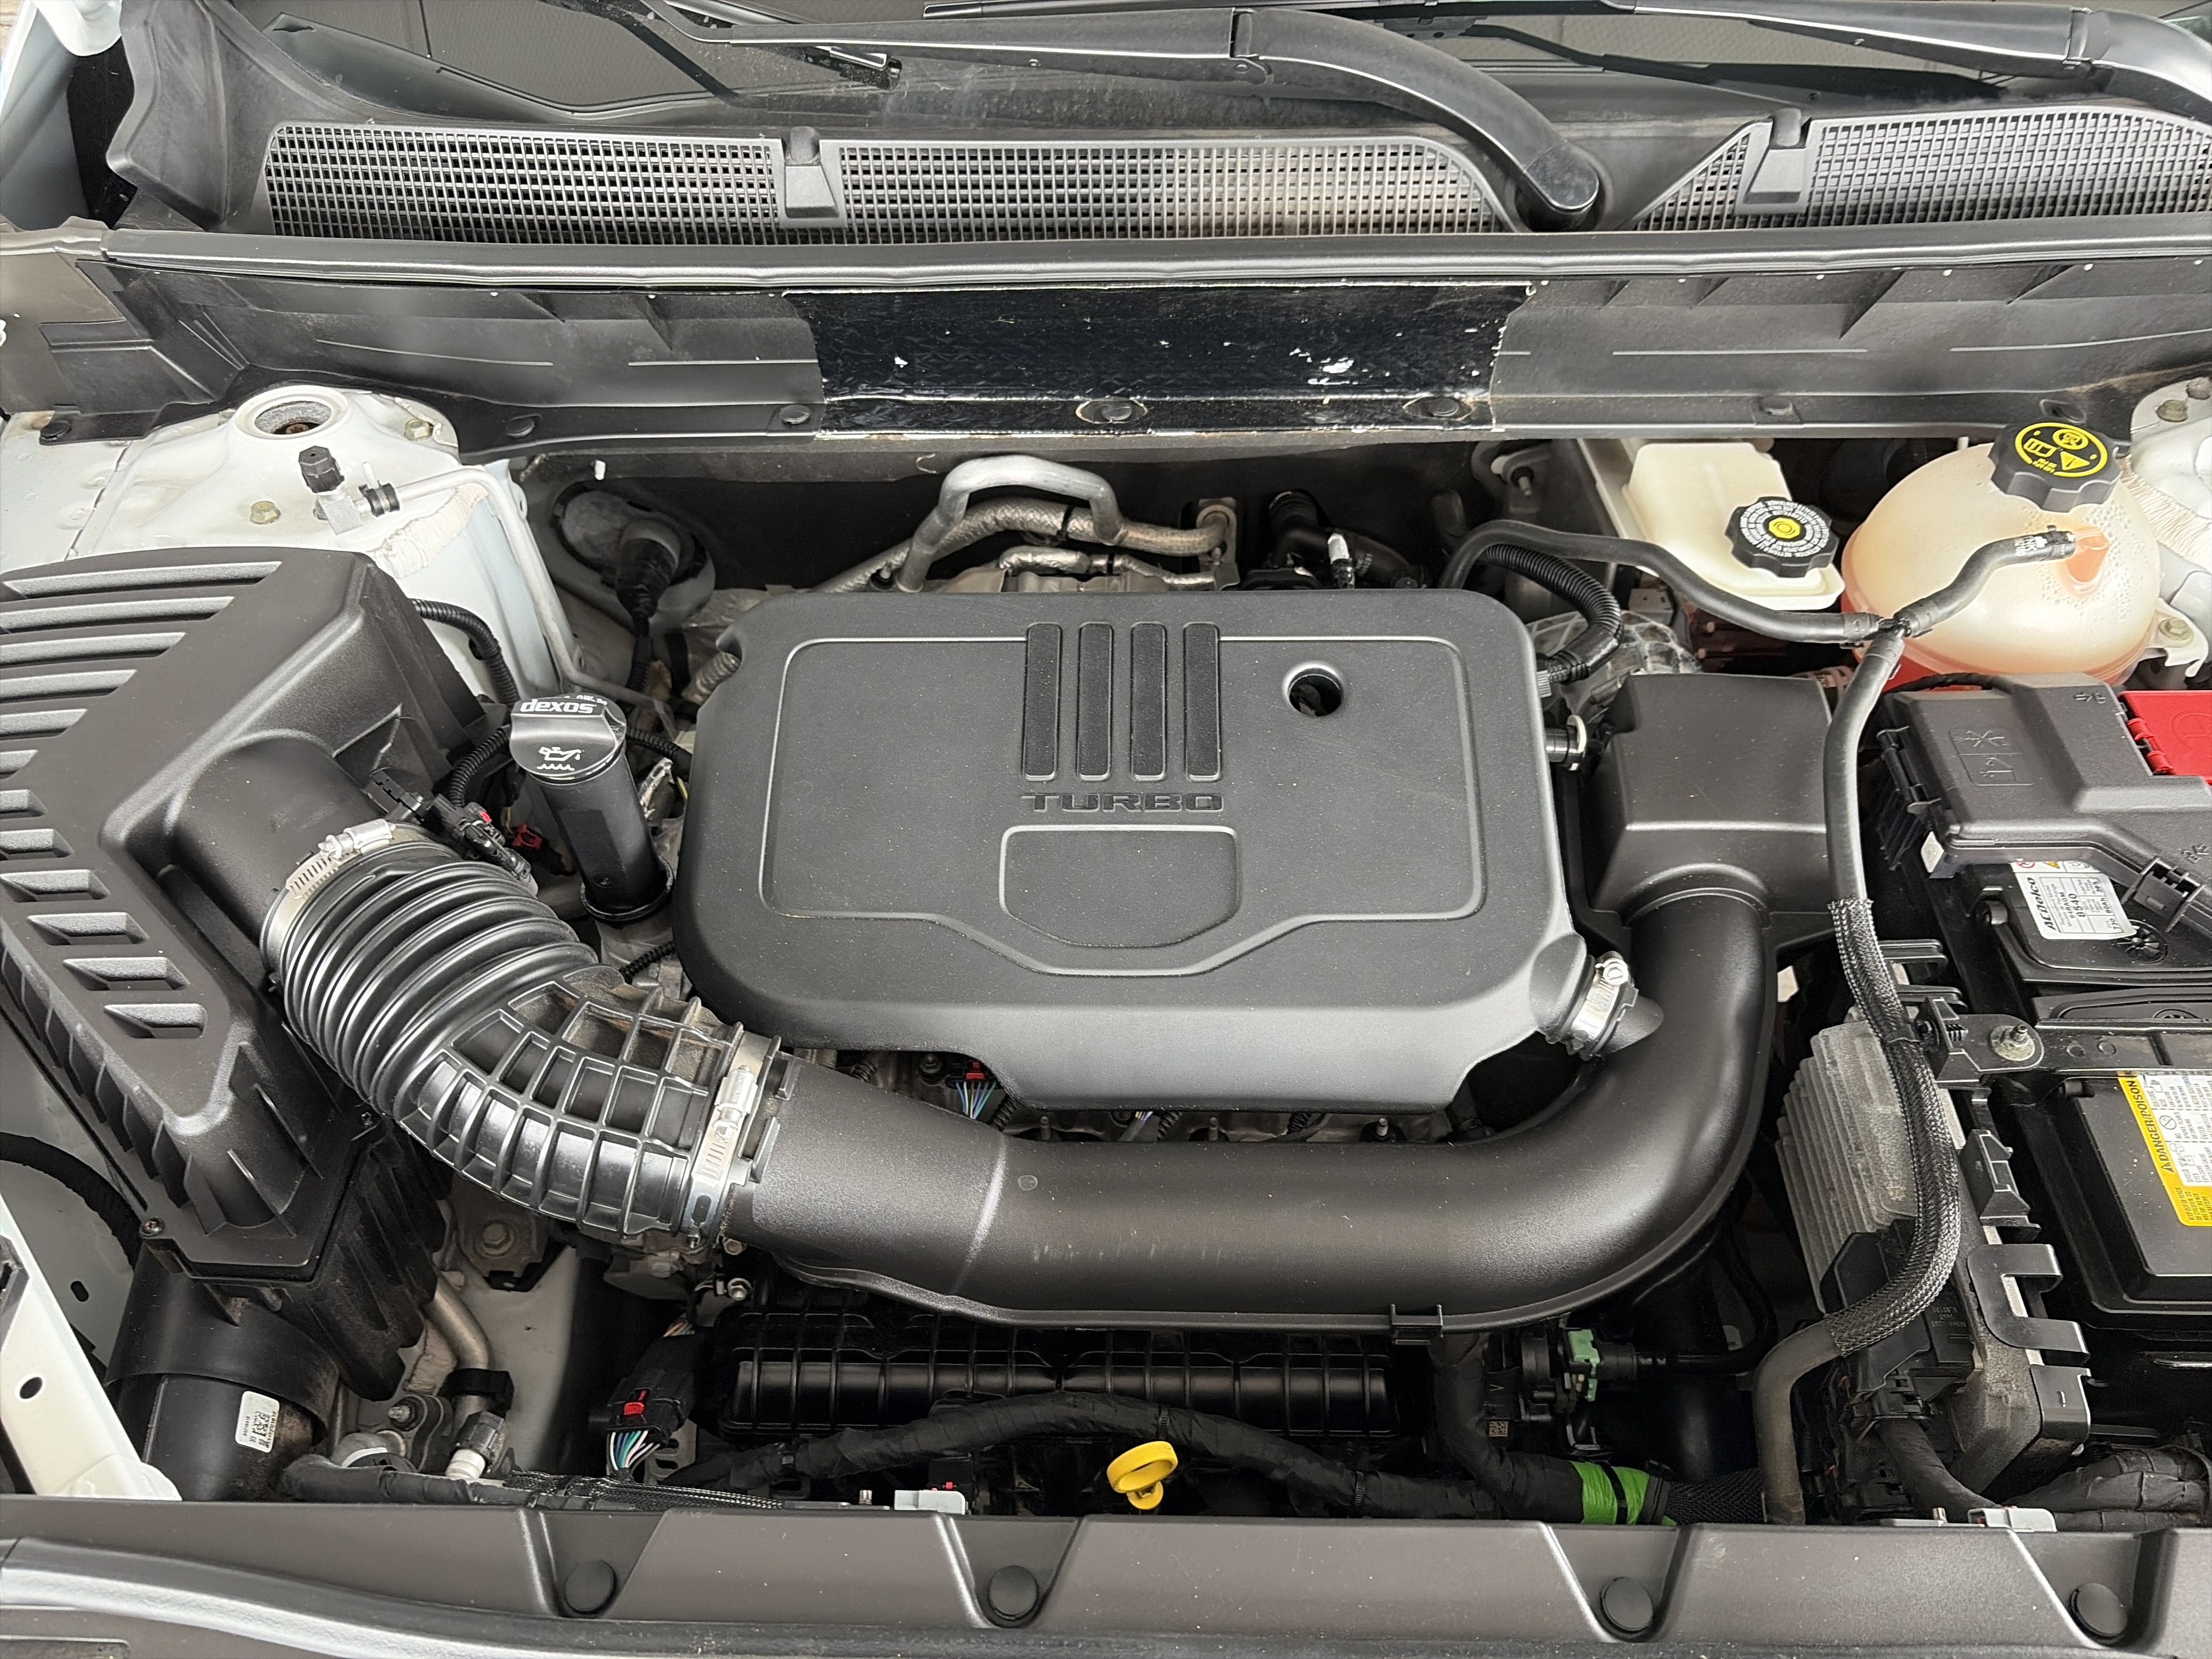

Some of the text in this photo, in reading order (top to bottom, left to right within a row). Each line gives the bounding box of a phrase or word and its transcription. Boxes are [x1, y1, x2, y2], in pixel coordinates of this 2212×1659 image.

[520, 699, 595, 714] dexos
[1020, 793, 1224, 813] TURBO
[2027, 877, 2056, 930] ACDelco
[2067, 893, 2086, 917] 8540
[2126, 1080, 2169, 1160] DANGER/POISON
